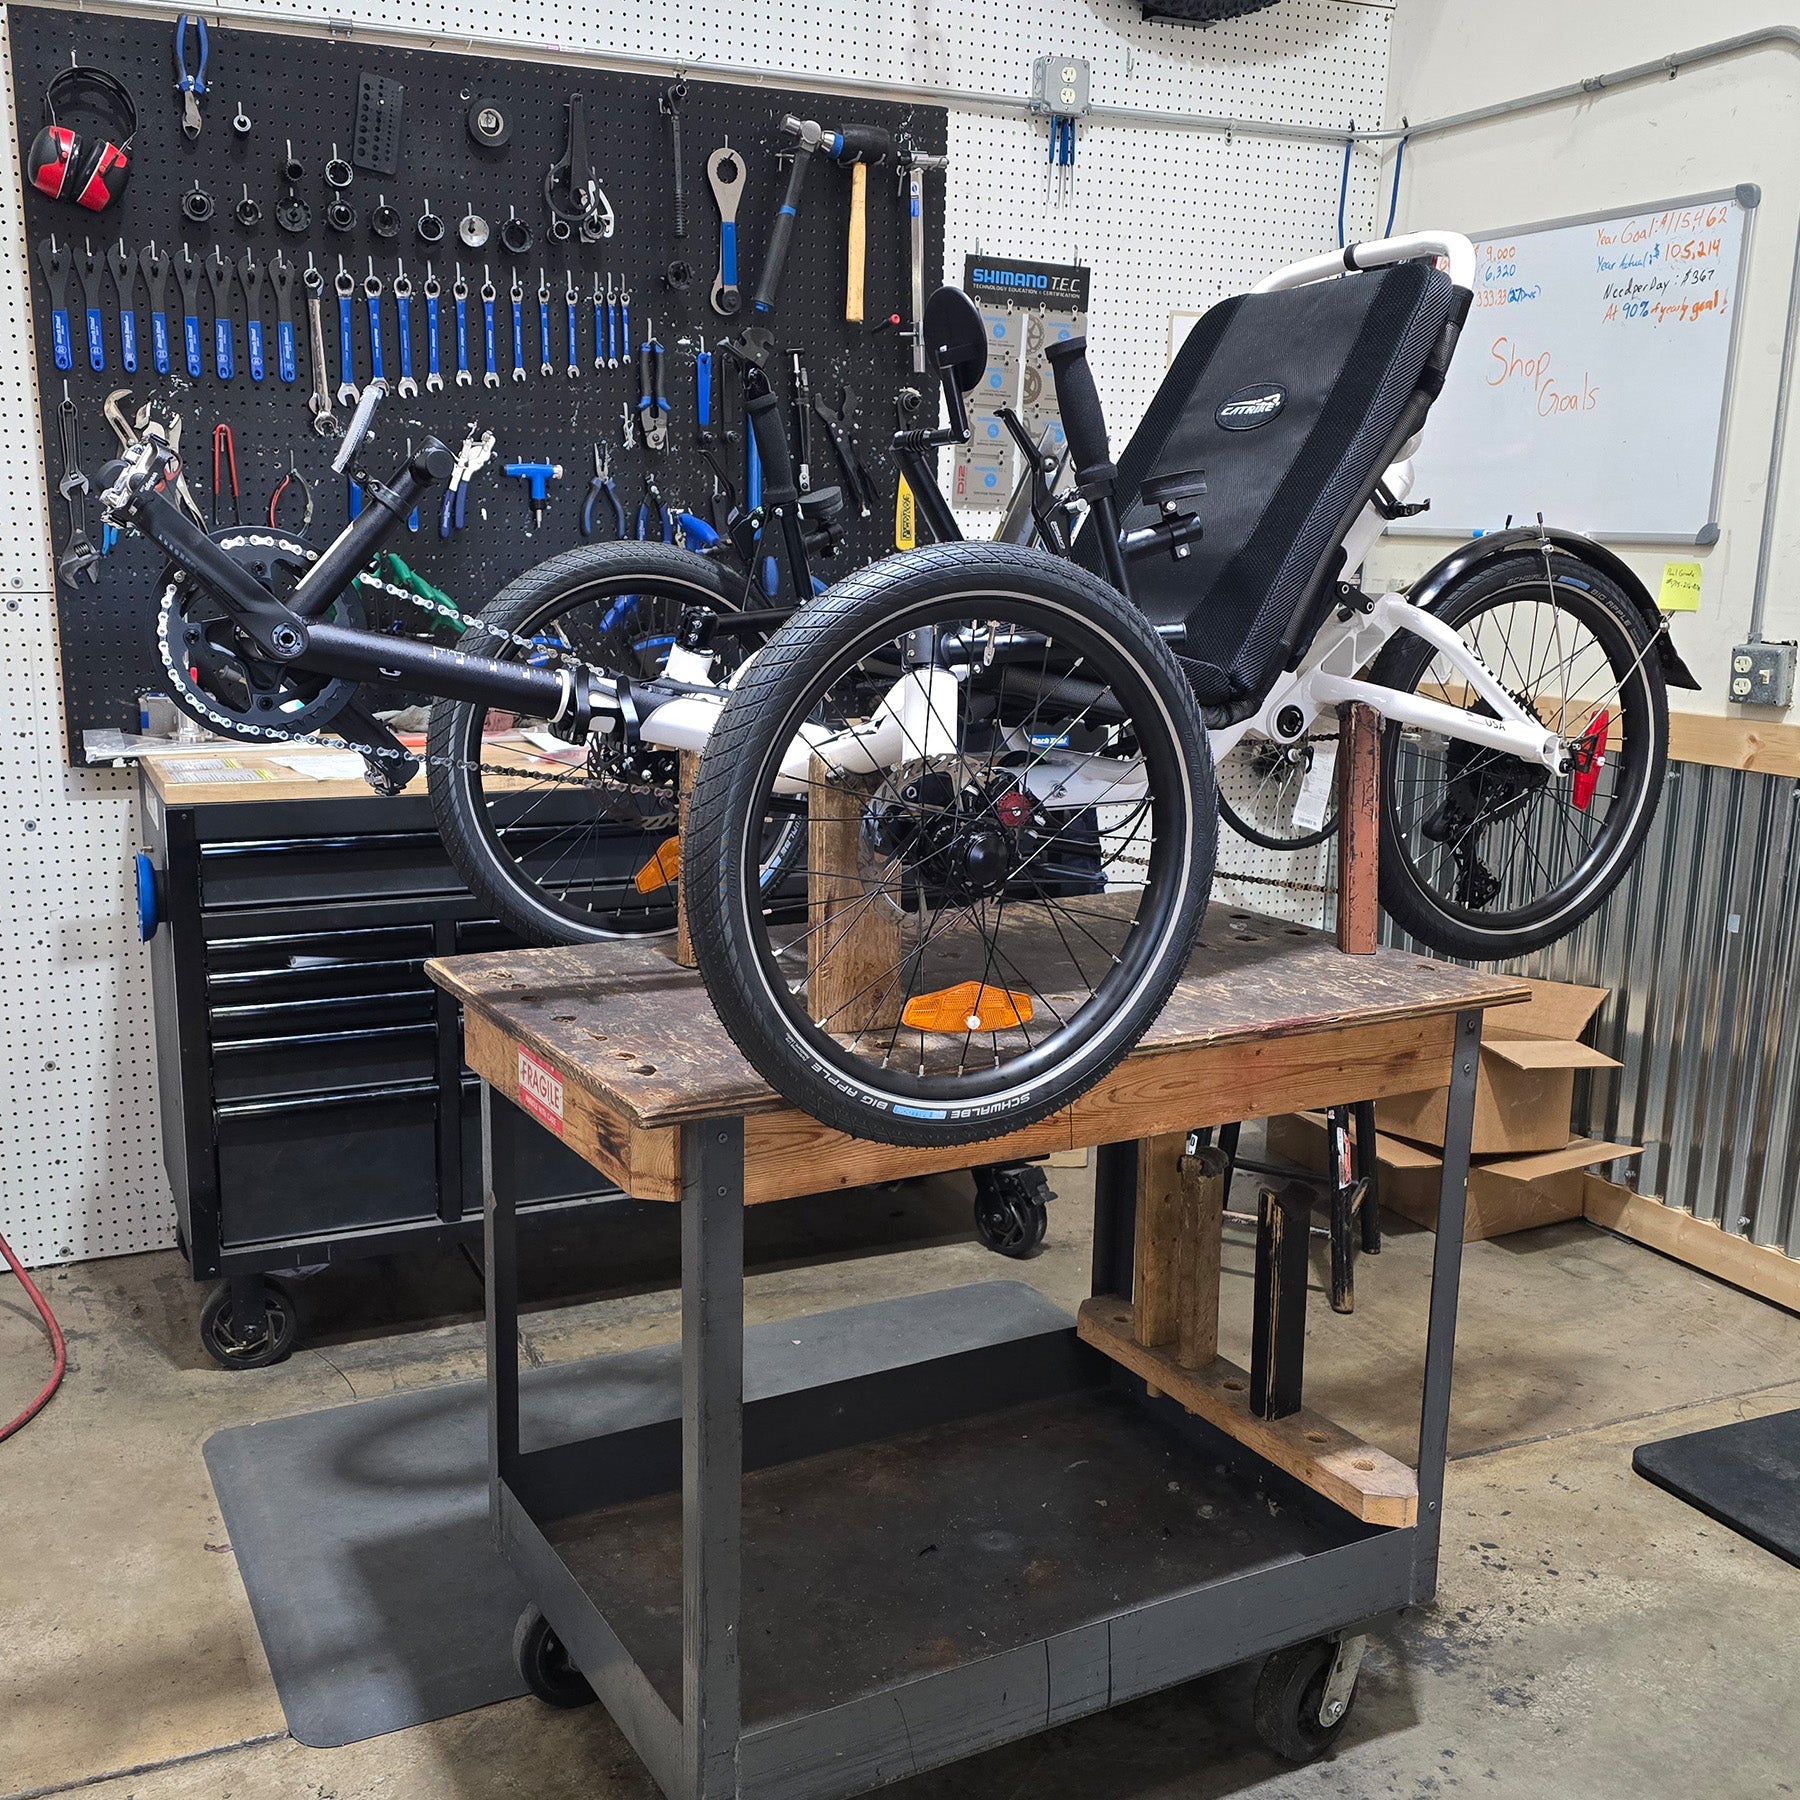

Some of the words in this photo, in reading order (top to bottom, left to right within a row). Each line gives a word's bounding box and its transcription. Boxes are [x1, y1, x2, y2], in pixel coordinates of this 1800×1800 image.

[1596, 228, 1617, 246] Year
[1485, 264, 1516, 282] 6,320
[1597, 255, 1616, 273] Year
[973, 268, 1047, 289] SHIMANO
[973, 283, 1007, 292] TECHNOLOGY
[1008, 287, 1037, 295] EDUCATION
[1043, 290, 1080, 299] CERTIFICATION
[1622, 301, 1650, 319] 90%
[1486, 337, 1550, 390] Shop
[1537, 372, 1600, 417] Goals
[1590, 588, 1607, 602] BIG
[1605, 601, 1632, 627] APPLE
[1484, 718, 1506, 732] USA
[521, 1060, 560, 1110] FRAGILE
[811, 1063, 858, 1097] APPLE
[860, 1096, 888, 1110] BIG
[951, 1093, 1030, 1119] SCHWALBE
